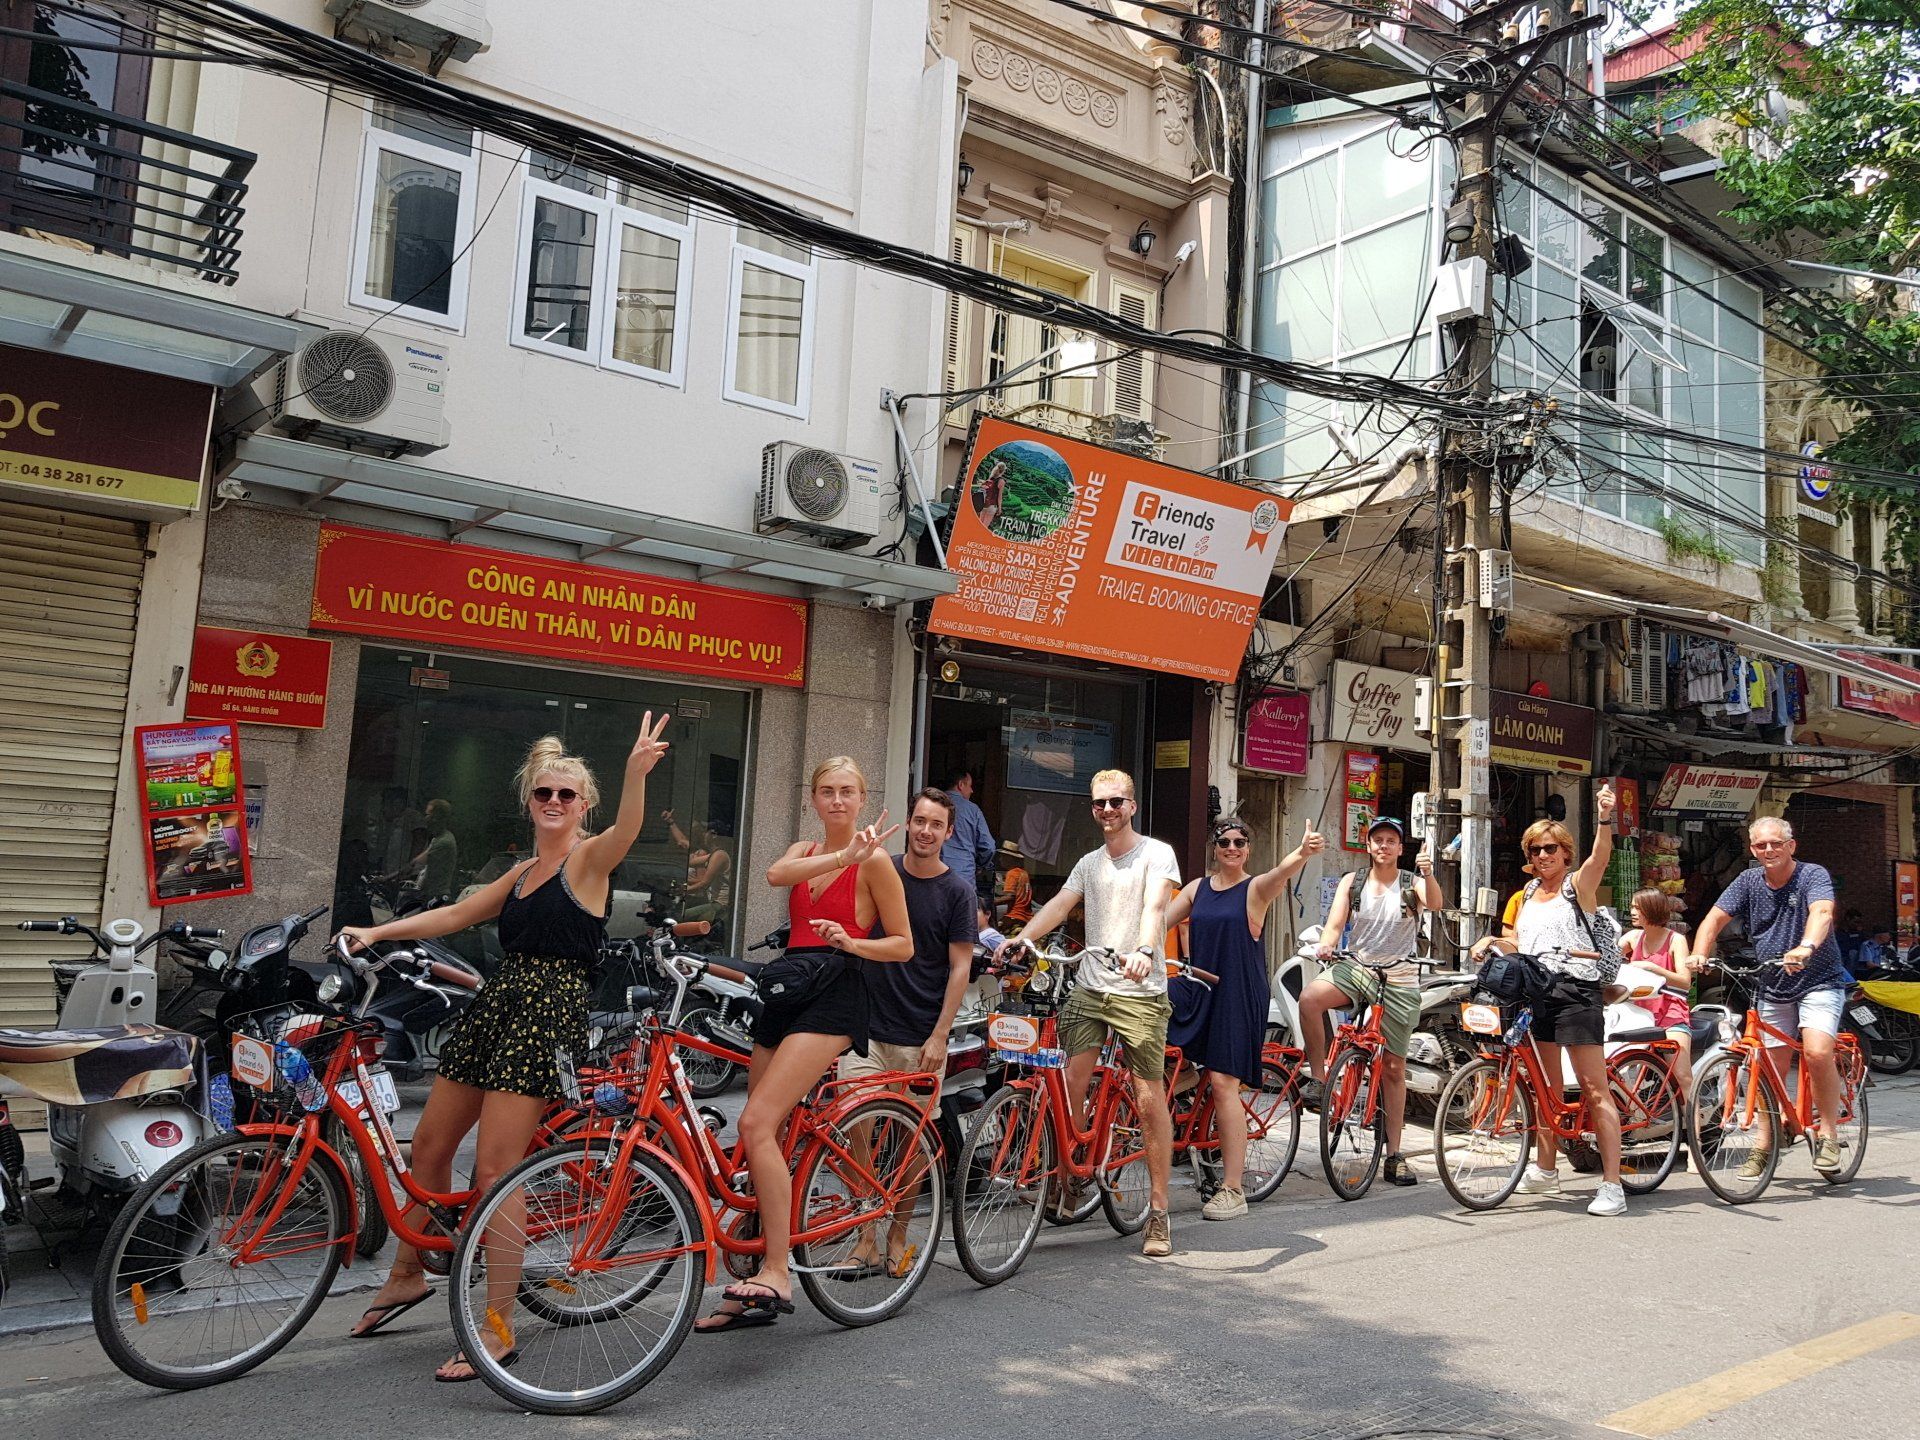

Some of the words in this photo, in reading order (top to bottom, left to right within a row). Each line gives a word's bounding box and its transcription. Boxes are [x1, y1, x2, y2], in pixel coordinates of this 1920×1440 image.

[406, 346, 443, 360] Panasonic
[21, 464, 39, 476] 04
[43, 467, 61, 480] 38
[66, 471, 91, 484] 281
[97, 476, 123, 489] 677
[1030, 509, 1074, 530] TREKKING
[1137, 495, 1216, 531] Friends
[992, 529, 1029, 544] CULTURAL
[1030, 536, 1055, 550] INFO
[1000, 516, 1030, 534] TRAIN
[1031, 525, 1071, 543] TICKETS
[1057, 470, 1107, 605] ADVENTURE
[1131, 520, 1186, 551] Travel
[955, 546, 971, 555] OPEN
[972, 549, 985, 558] BUS
[986, 551, 1006, 561] TICKET
[1006, 550, 1036, 568] SAPA
[1124, 546, 1217, 580] Vietnam
[959, 556, 990, 573] HALONG
[990, 562, 1003, 577] BAY
[1005, 565, 1034, 582] CRUISES
[1029, 557, 1051, 599] BIKING
[1041, 543, 1068, 601] EXPERIENCES
[467, 565, 535, 597] CÔNG
[542, 580, 576, 603] AN
[582, 585, 645, 613] NHÂN
[651, 593, 696, 621] DÂN
[980, 575, 1030, 596] CLIMBING
[963, 586, 1019, 608] EXPEDITIONS
[1097, 575, 1145, 605] TRAVEL
[1147, 586, 1207, 616] BOOKING
[1208, 599, 1255, 626] OFFICE
[982, 603, 1016, 618] TOURS
[1035, 602, 1051, 624] REAL
[348, 583, 375, 611] VÌ
[380, 591, 454, 621] NƯỚC
[461, 602, 528, 631] QUÊN
[534, 611, 602, 644] THÂN,
[609, 619, 632, 645] VÌ
[636, 624, 682, 652] DÂN
[689, 634, 743, 663] PHỤC
[749, 642, 783, 669] VỤ!
[940, 620, 958, 631] HANG
[975, 625, 996, 637] STREET
[998, 630, 1021, 641] HOTLINE
[1285, 669, 1296, 681] 60
[210, 685, 225, 695] AN
[227, 685, 266, 700] PHƯỜNG
[1348, 671, 1401, 709] Coffee
[1518, 701, 1531, 713] Cửa
[1531, 703, 1548, 717] Hàng
[1495, 714, 1523, 739] LÂM
[1526, 722, 1564, 745] OANH
[997, 1030, 1019, 1039] Around
[239, 1056, 257, 1069] Around
